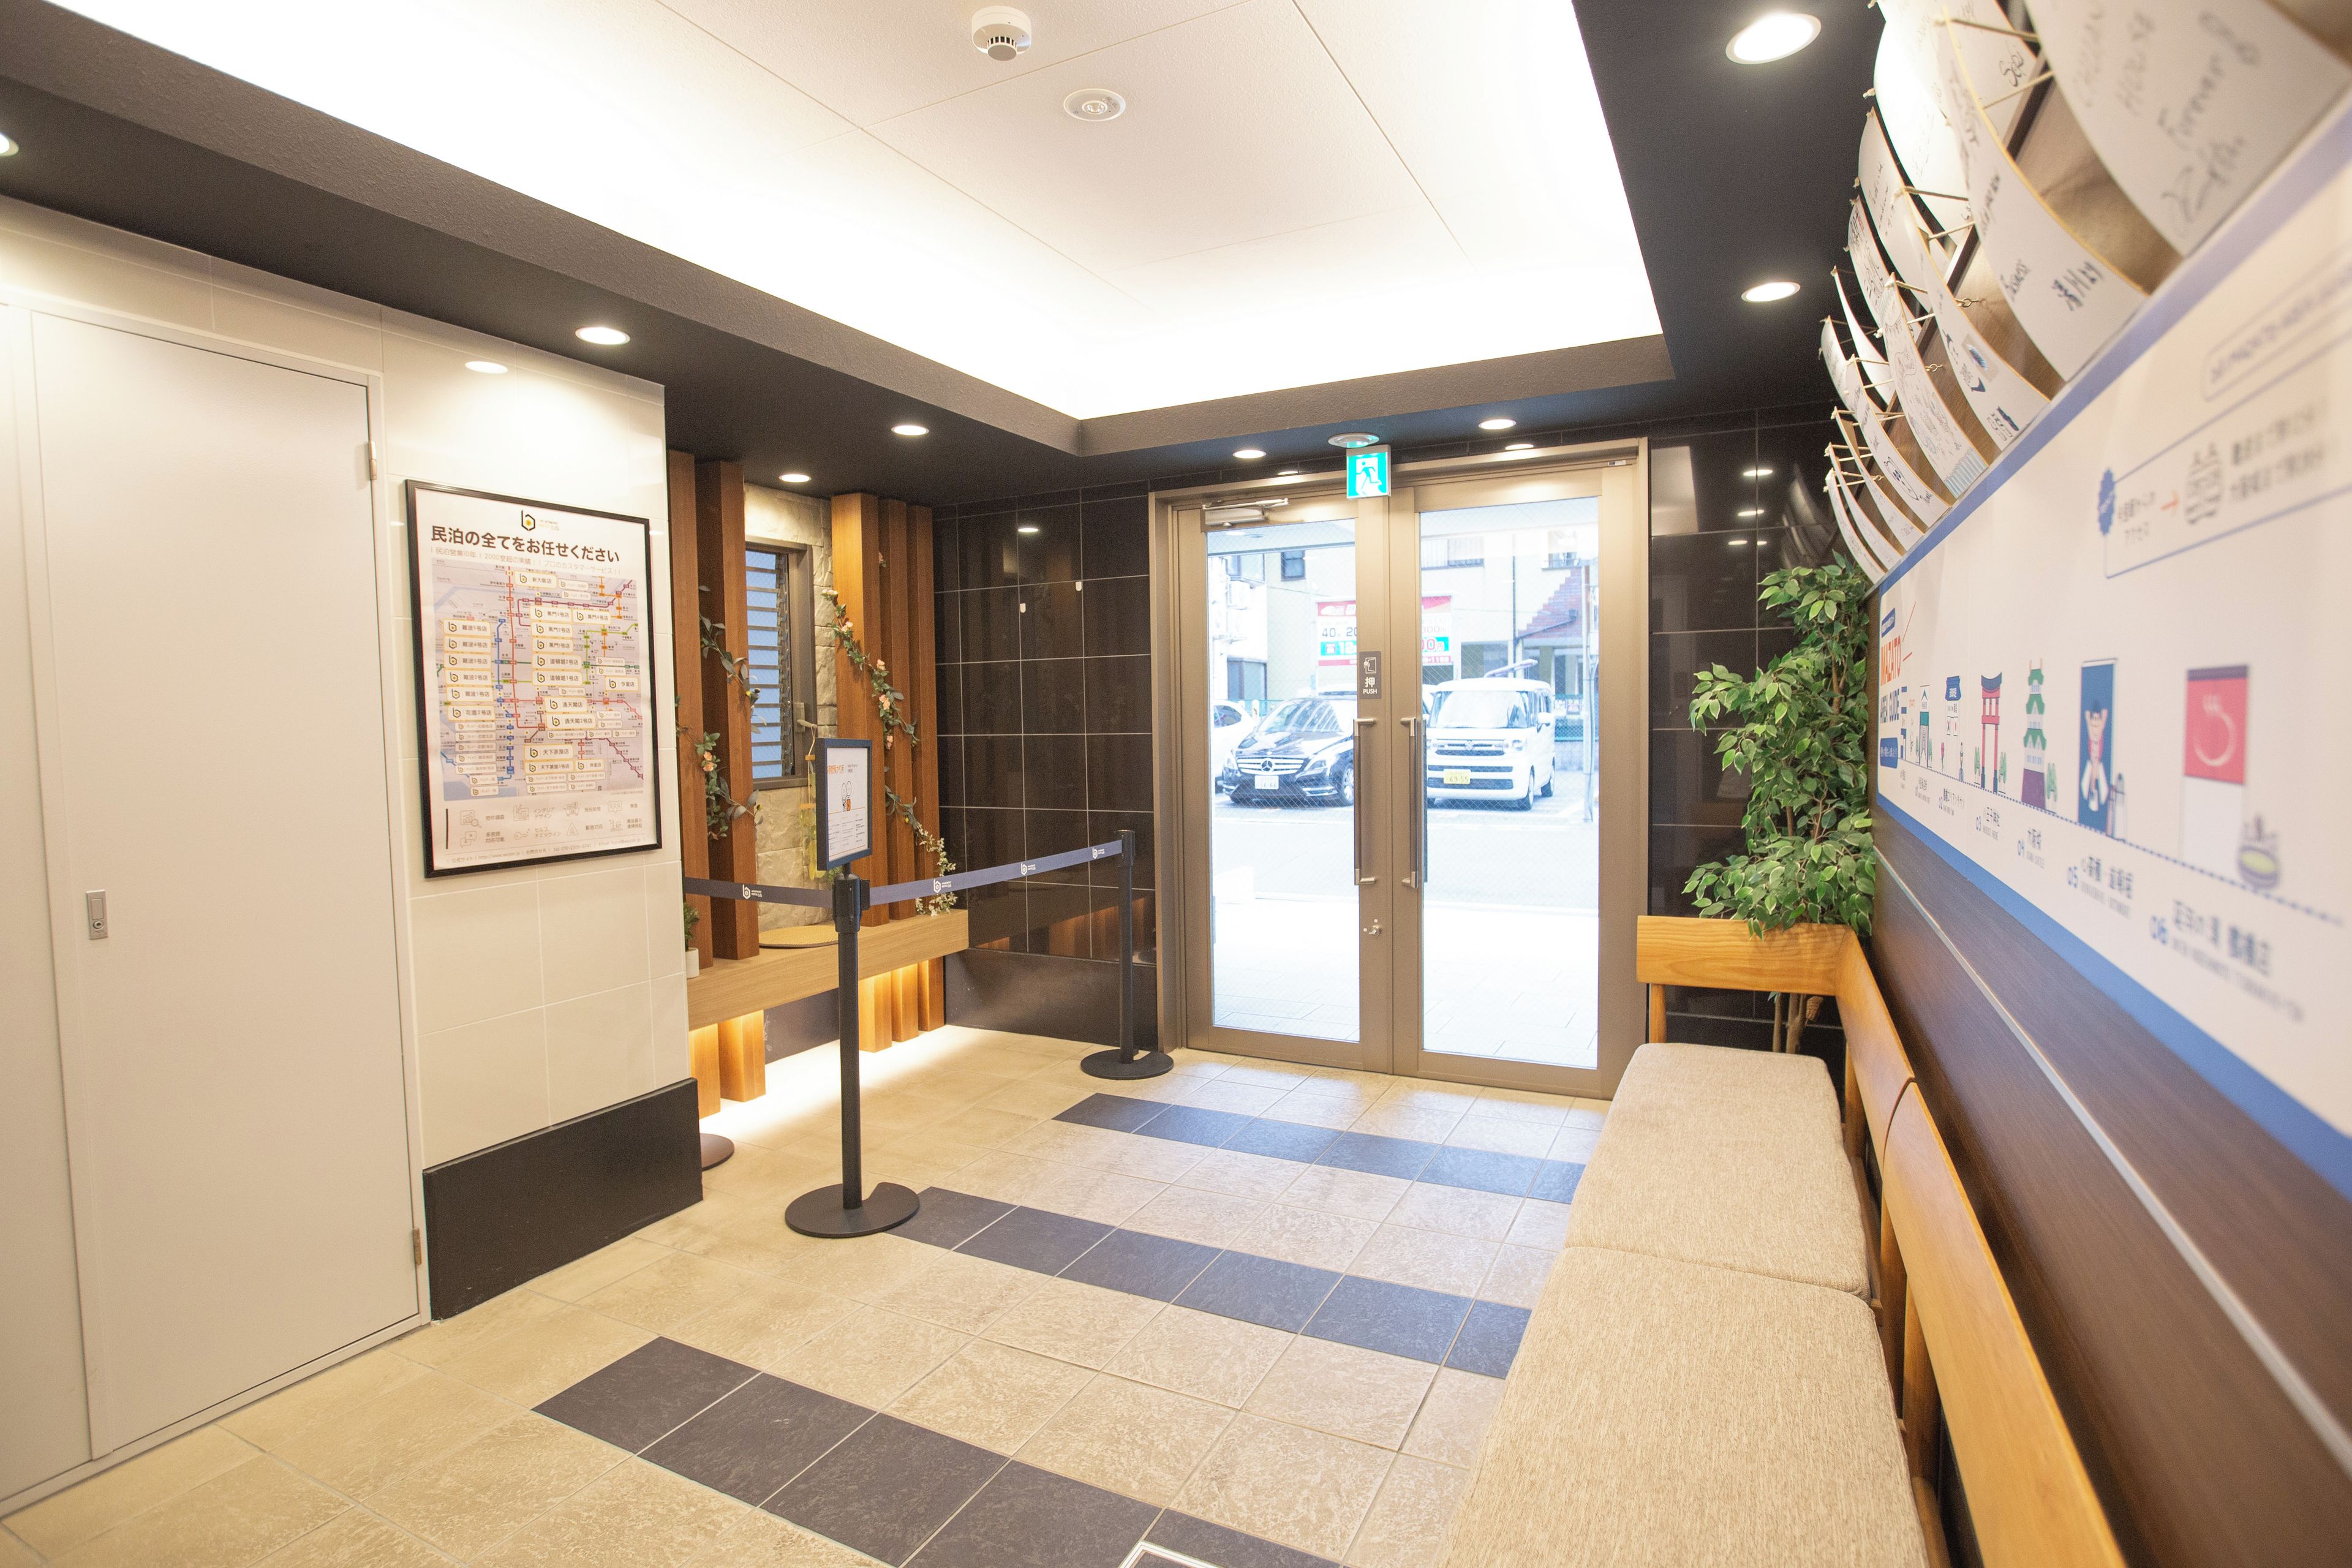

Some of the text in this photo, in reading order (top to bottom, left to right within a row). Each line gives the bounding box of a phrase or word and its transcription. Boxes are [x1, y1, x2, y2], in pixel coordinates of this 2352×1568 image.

[431, 525, 620, 562] 民泊の全てをお任せください
[1365, 677, 1375, 687] 押
[2018, 838, 2025, 858] 04
[2068, 865, 2078, 888] 05
[2149, 915, 2168, 945] 06
